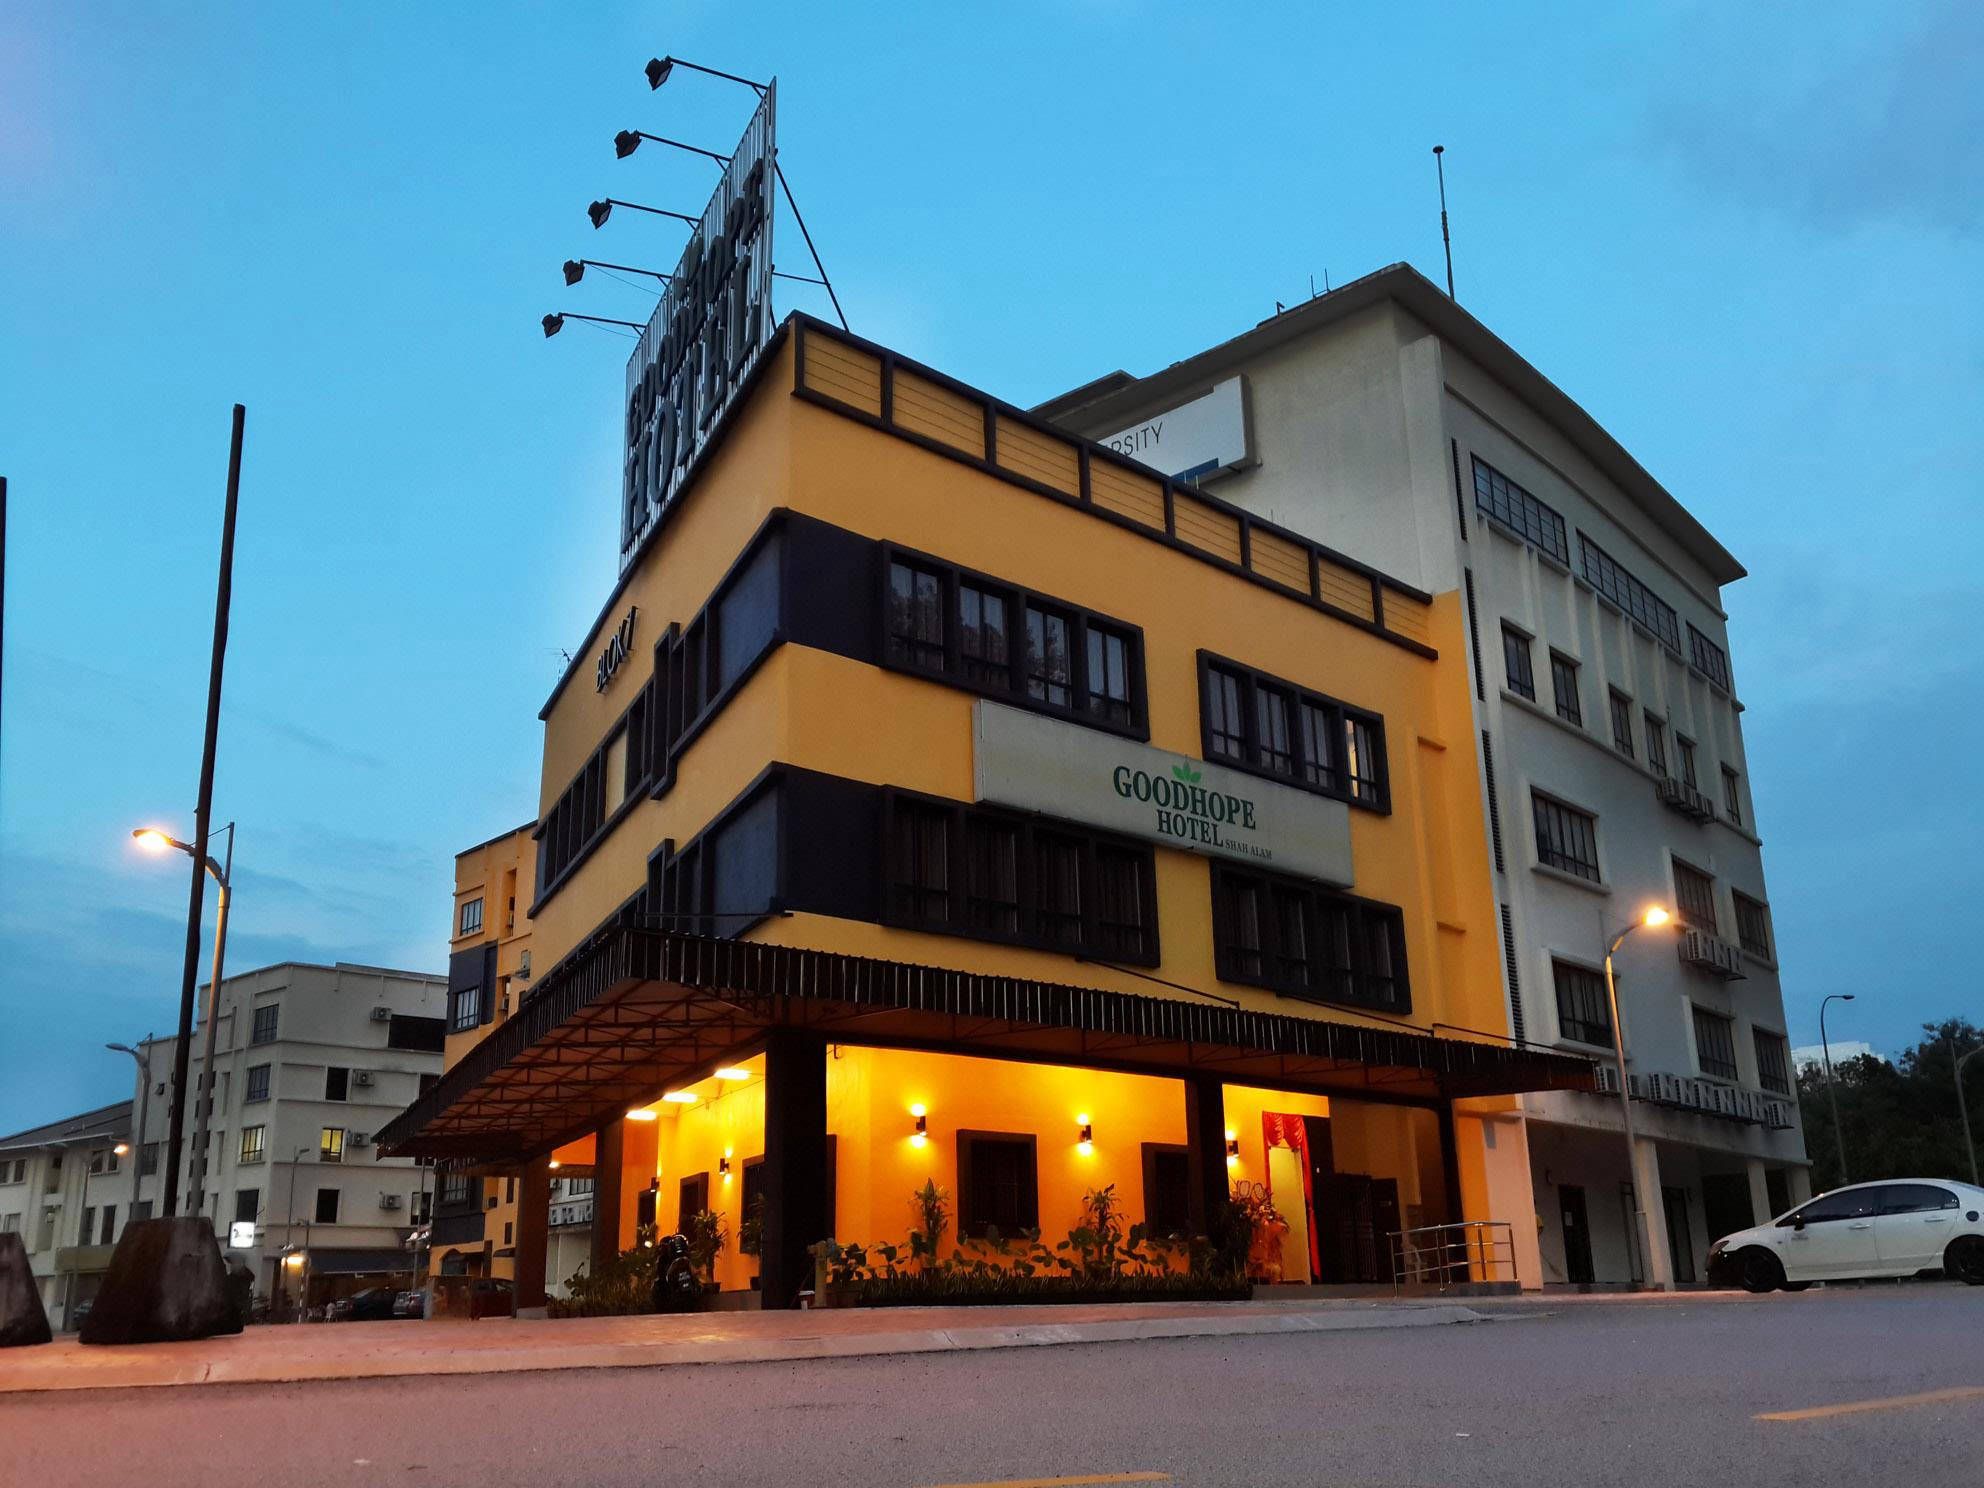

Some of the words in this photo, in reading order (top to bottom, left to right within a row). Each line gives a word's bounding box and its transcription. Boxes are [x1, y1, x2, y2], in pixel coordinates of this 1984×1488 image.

[626, 157, 764, 447] GOODHOPE
[622, 255, 761, 545] HOTEL
[1106, 421, 1163, 456] RSITY
[1113, 765, 1256, 830] GOODHOPE
[1156, 809, 1224, 847] HOTEL
[1225, 839, 1248, 853] SHAH
[1250, 845, 1273, 860] ALAM
